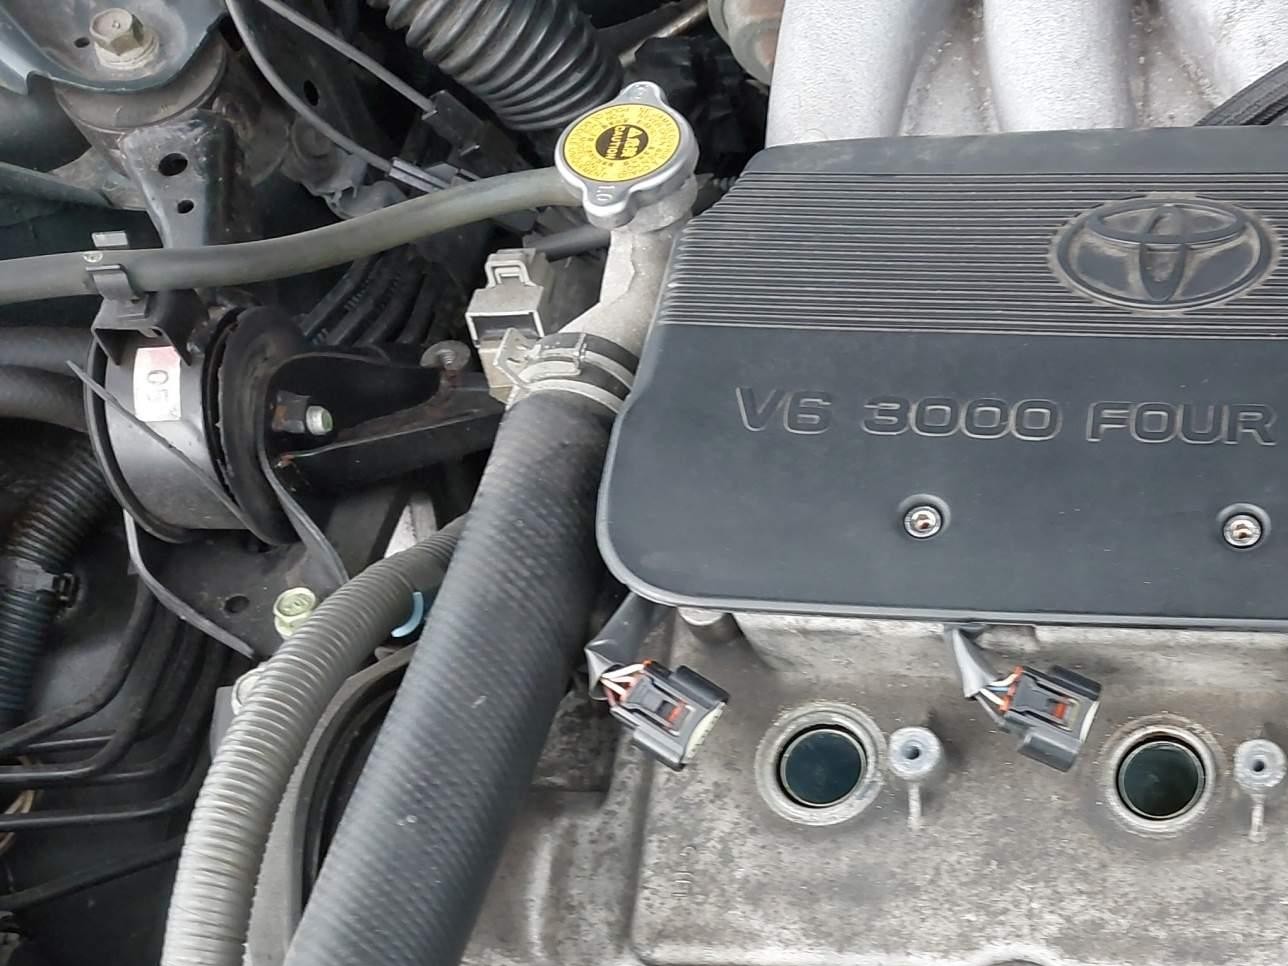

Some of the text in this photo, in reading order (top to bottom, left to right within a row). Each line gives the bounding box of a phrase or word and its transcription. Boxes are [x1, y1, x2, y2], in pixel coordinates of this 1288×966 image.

[604, 125, 624, 161] CAUTION
[595, 184, 616, 202] 1.0
[735, 386, 833, 434] V6
[859, 396, 1060, 442] 3000
[1086, 401, 1278, 445] FOUR
